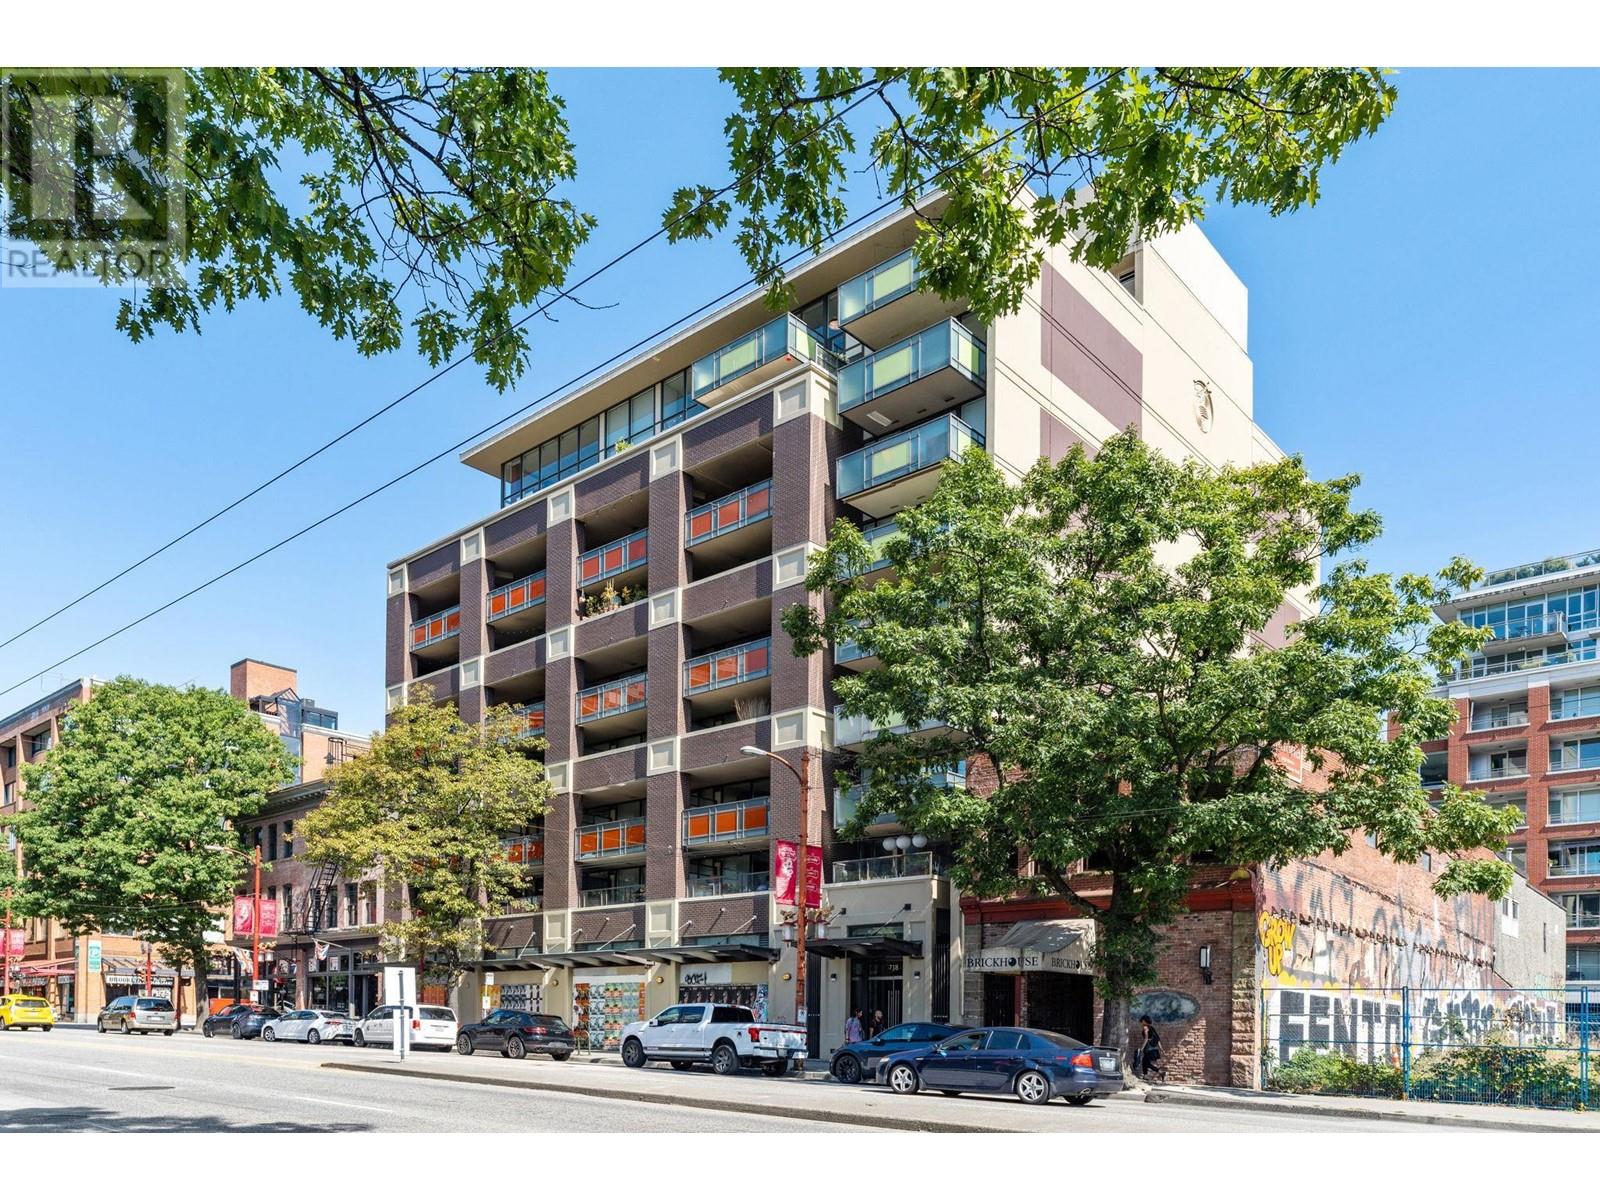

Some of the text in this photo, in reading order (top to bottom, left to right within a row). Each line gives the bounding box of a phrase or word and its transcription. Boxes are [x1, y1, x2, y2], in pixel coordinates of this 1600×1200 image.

[1258, 910, 1296, 950] GROW
[967, 956, 1039, 969] BRICKHOUSE
[1268, 943, 1283, 976] UP
